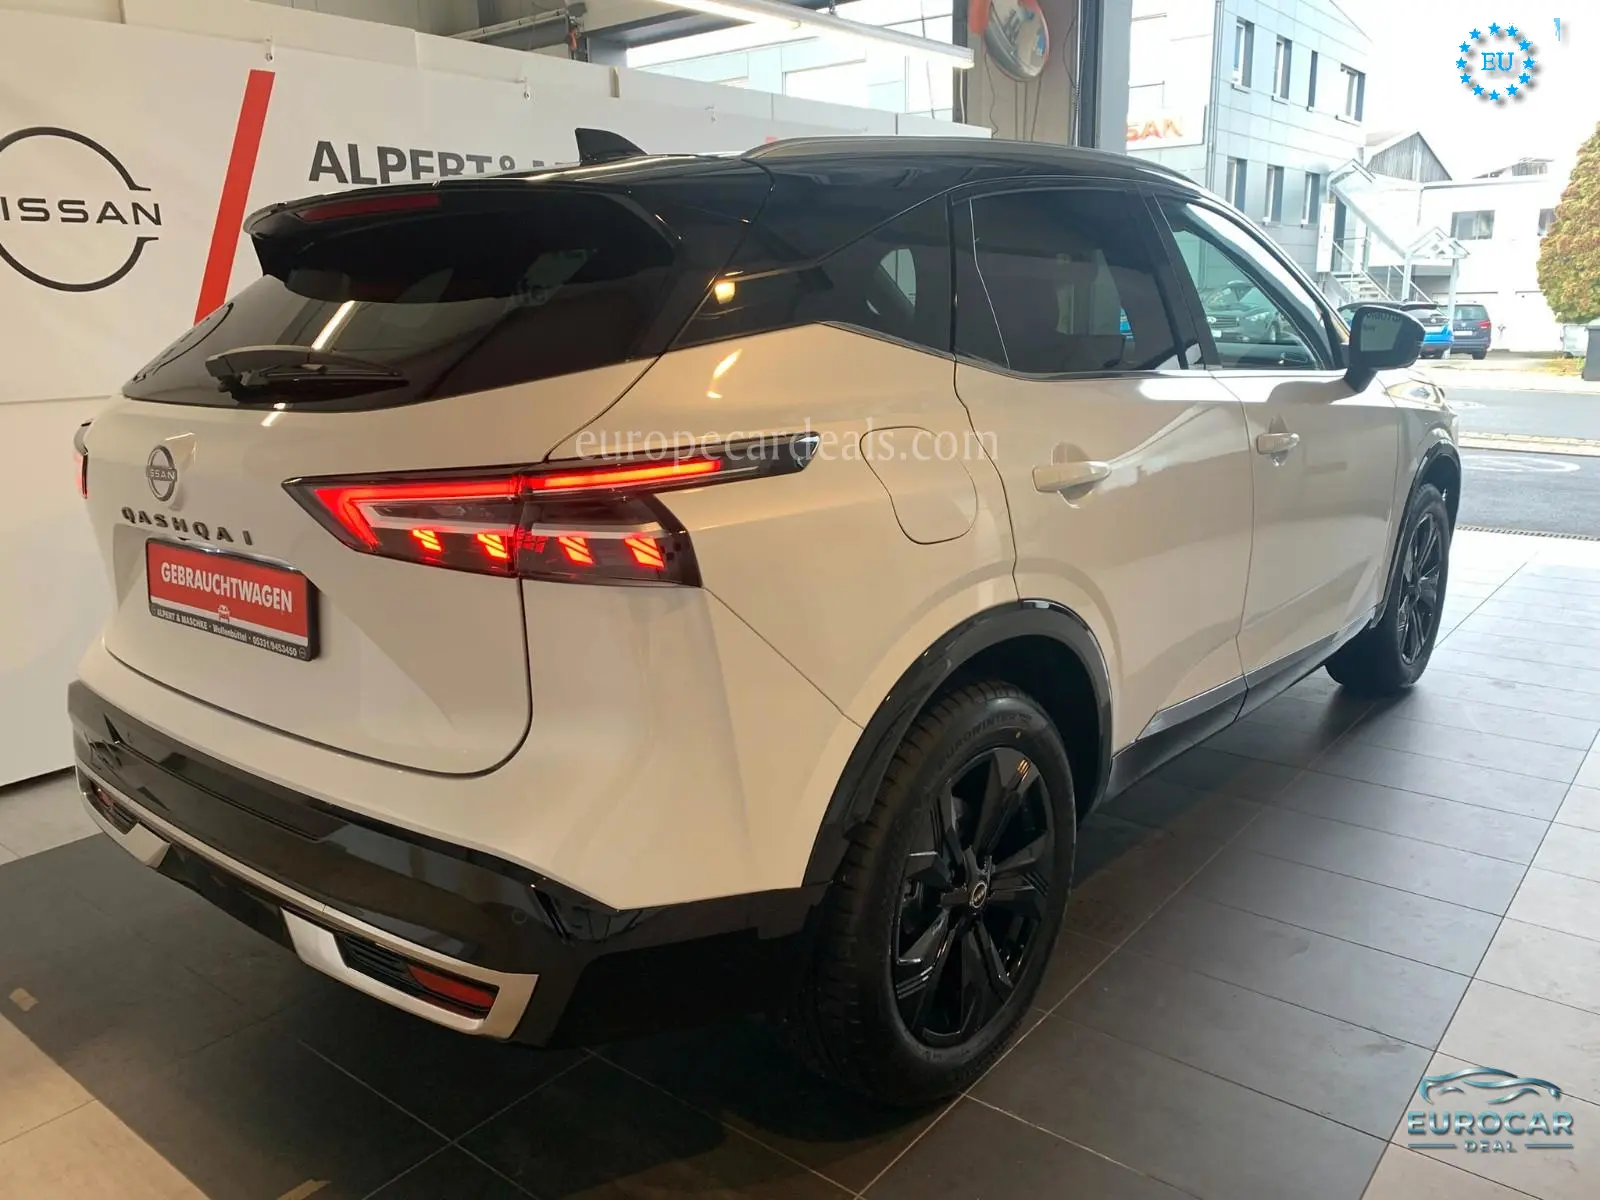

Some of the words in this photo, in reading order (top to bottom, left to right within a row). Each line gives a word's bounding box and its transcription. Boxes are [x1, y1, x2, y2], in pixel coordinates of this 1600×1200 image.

[121, 507, 254, 546] QASHQAI
[161, 561, 293, 614] GEBRAUCHTWAGEN
[156, 608, 176, 621] ALPERT
[181, 615, 208, 630] MASCHKE
